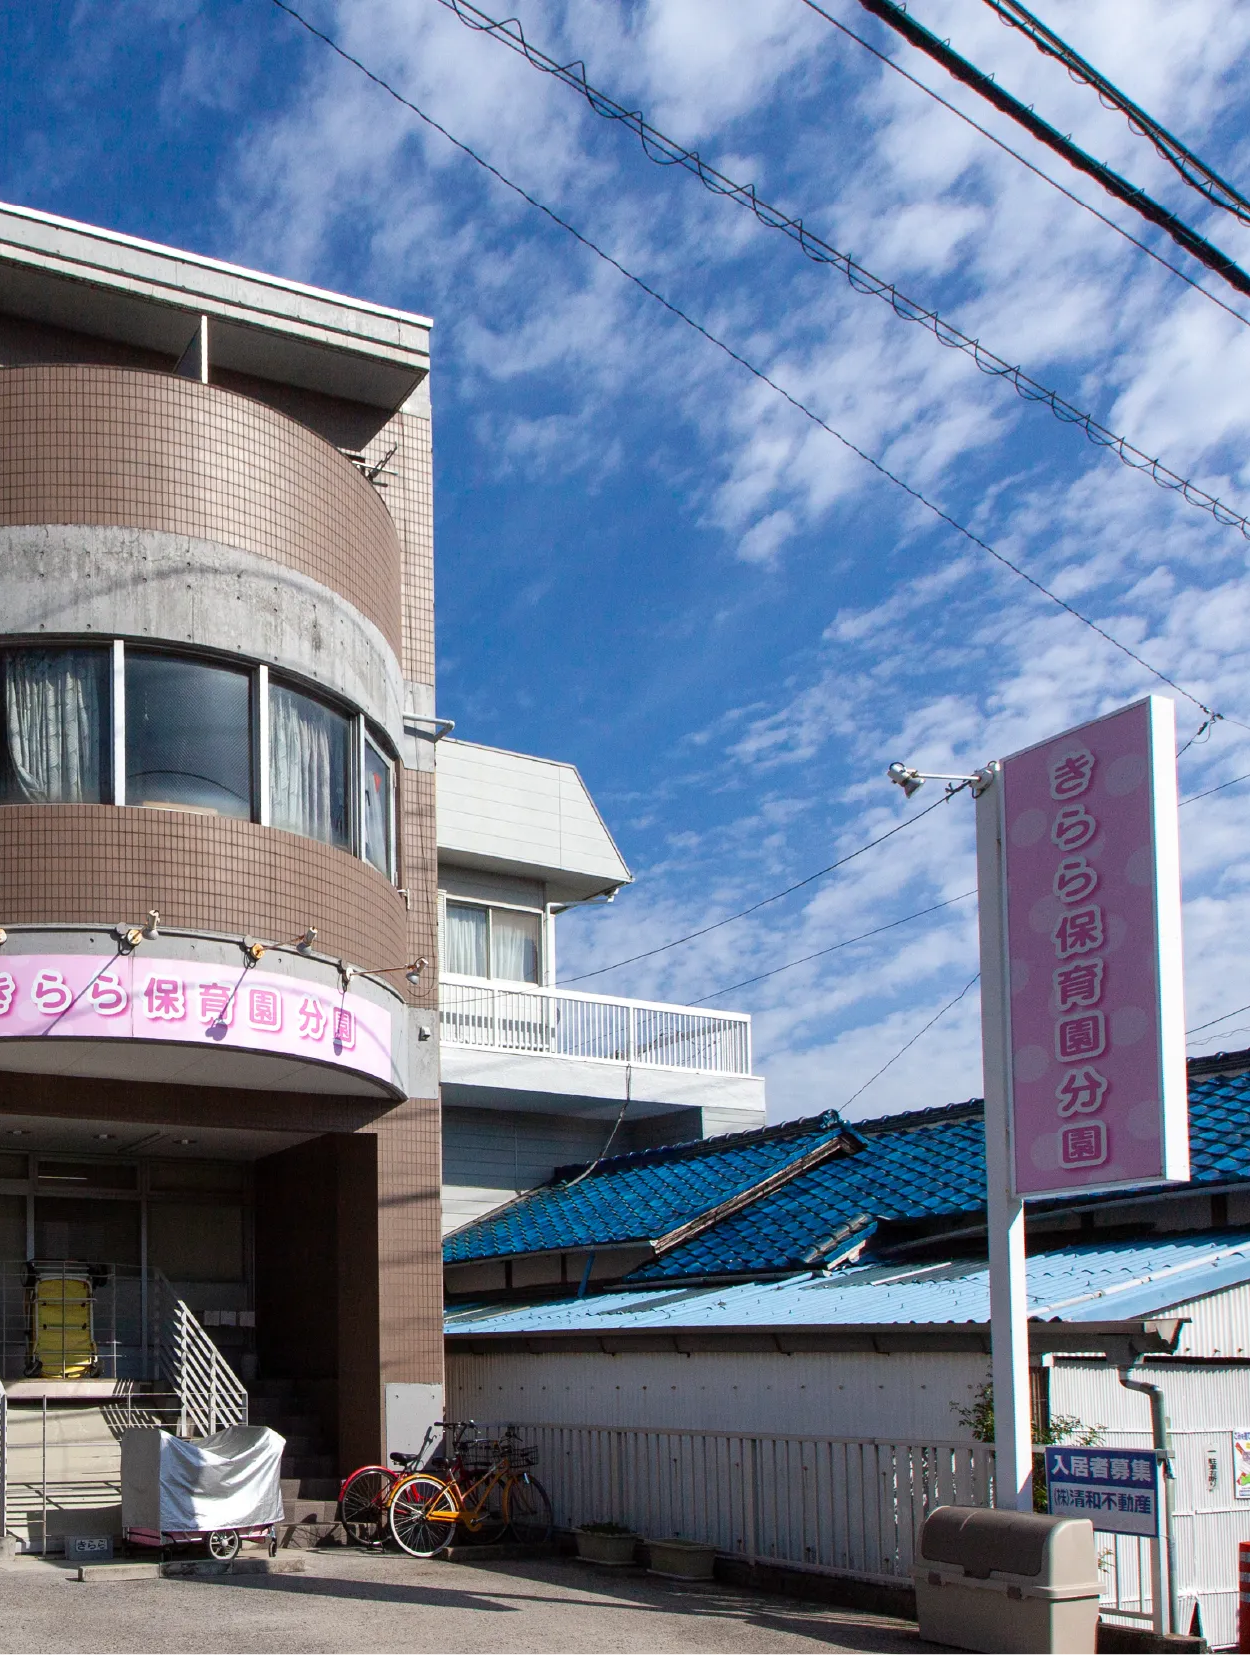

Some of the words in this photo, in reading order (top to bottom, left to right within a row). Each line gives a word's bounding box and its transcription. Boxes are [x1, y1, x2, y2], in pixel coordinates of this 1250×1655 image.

[1053, 751, 1106, 1168] きらら保育園分園
[1051, 1455, 1151, 1482] 入居者募集
[1053, 1488, 1151, 1514] (株)清和不動産
[78, 1540, 106, 1551] きらら
